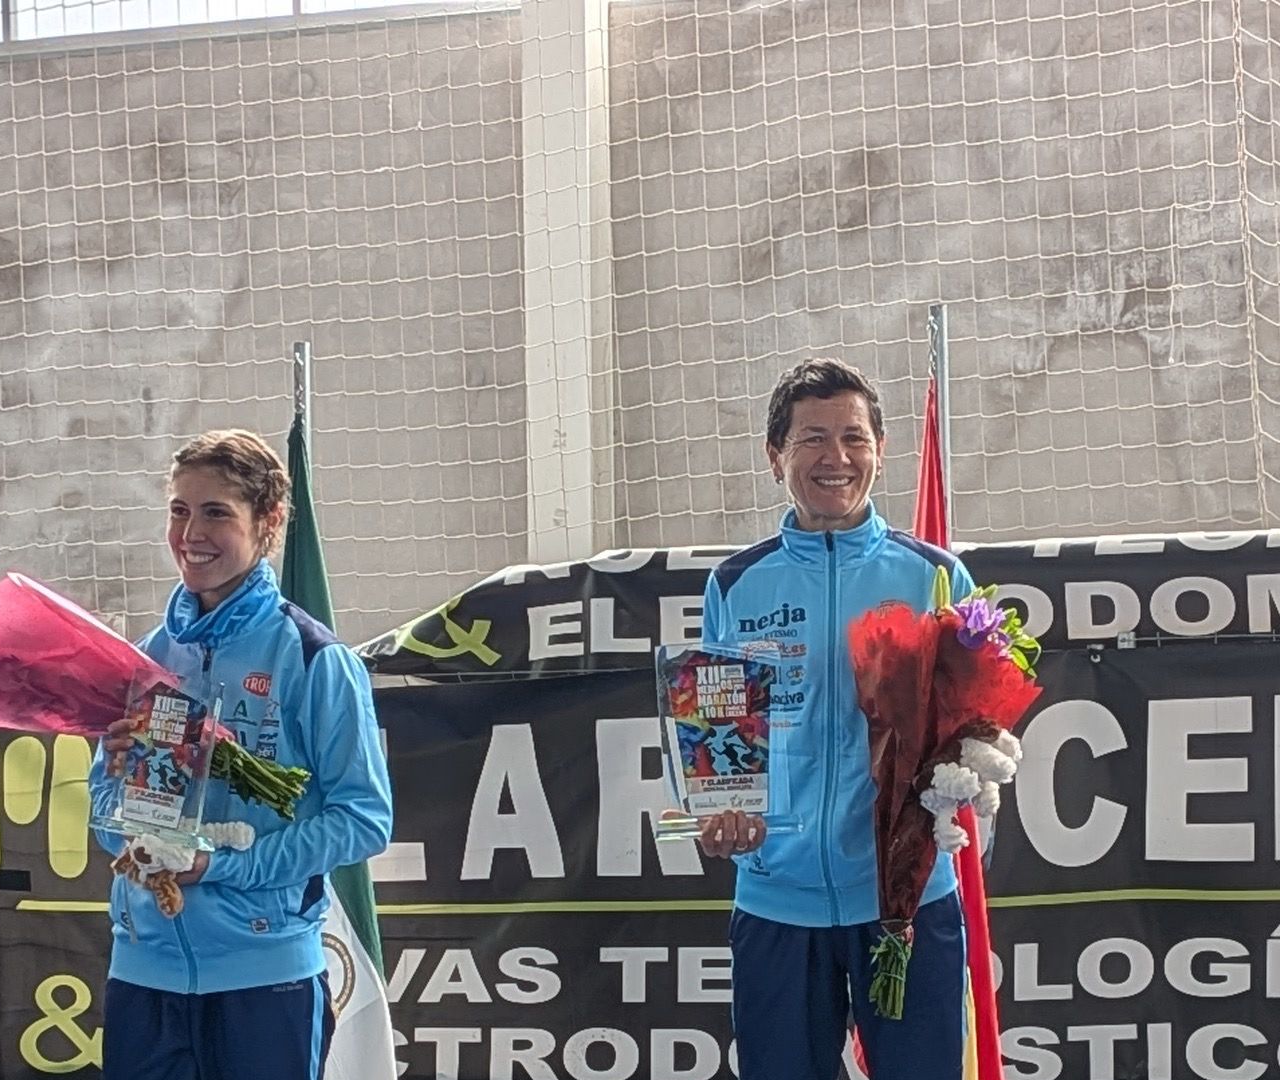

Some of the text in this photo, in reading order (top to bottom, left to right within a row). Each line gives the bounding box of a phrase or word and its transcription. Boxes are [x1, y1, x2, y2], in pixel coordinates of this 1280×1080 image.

[738, 603, 806, 632] nerja
[384, 946, 562, 1004] VAS
[19, 974, 103, 1074] &
